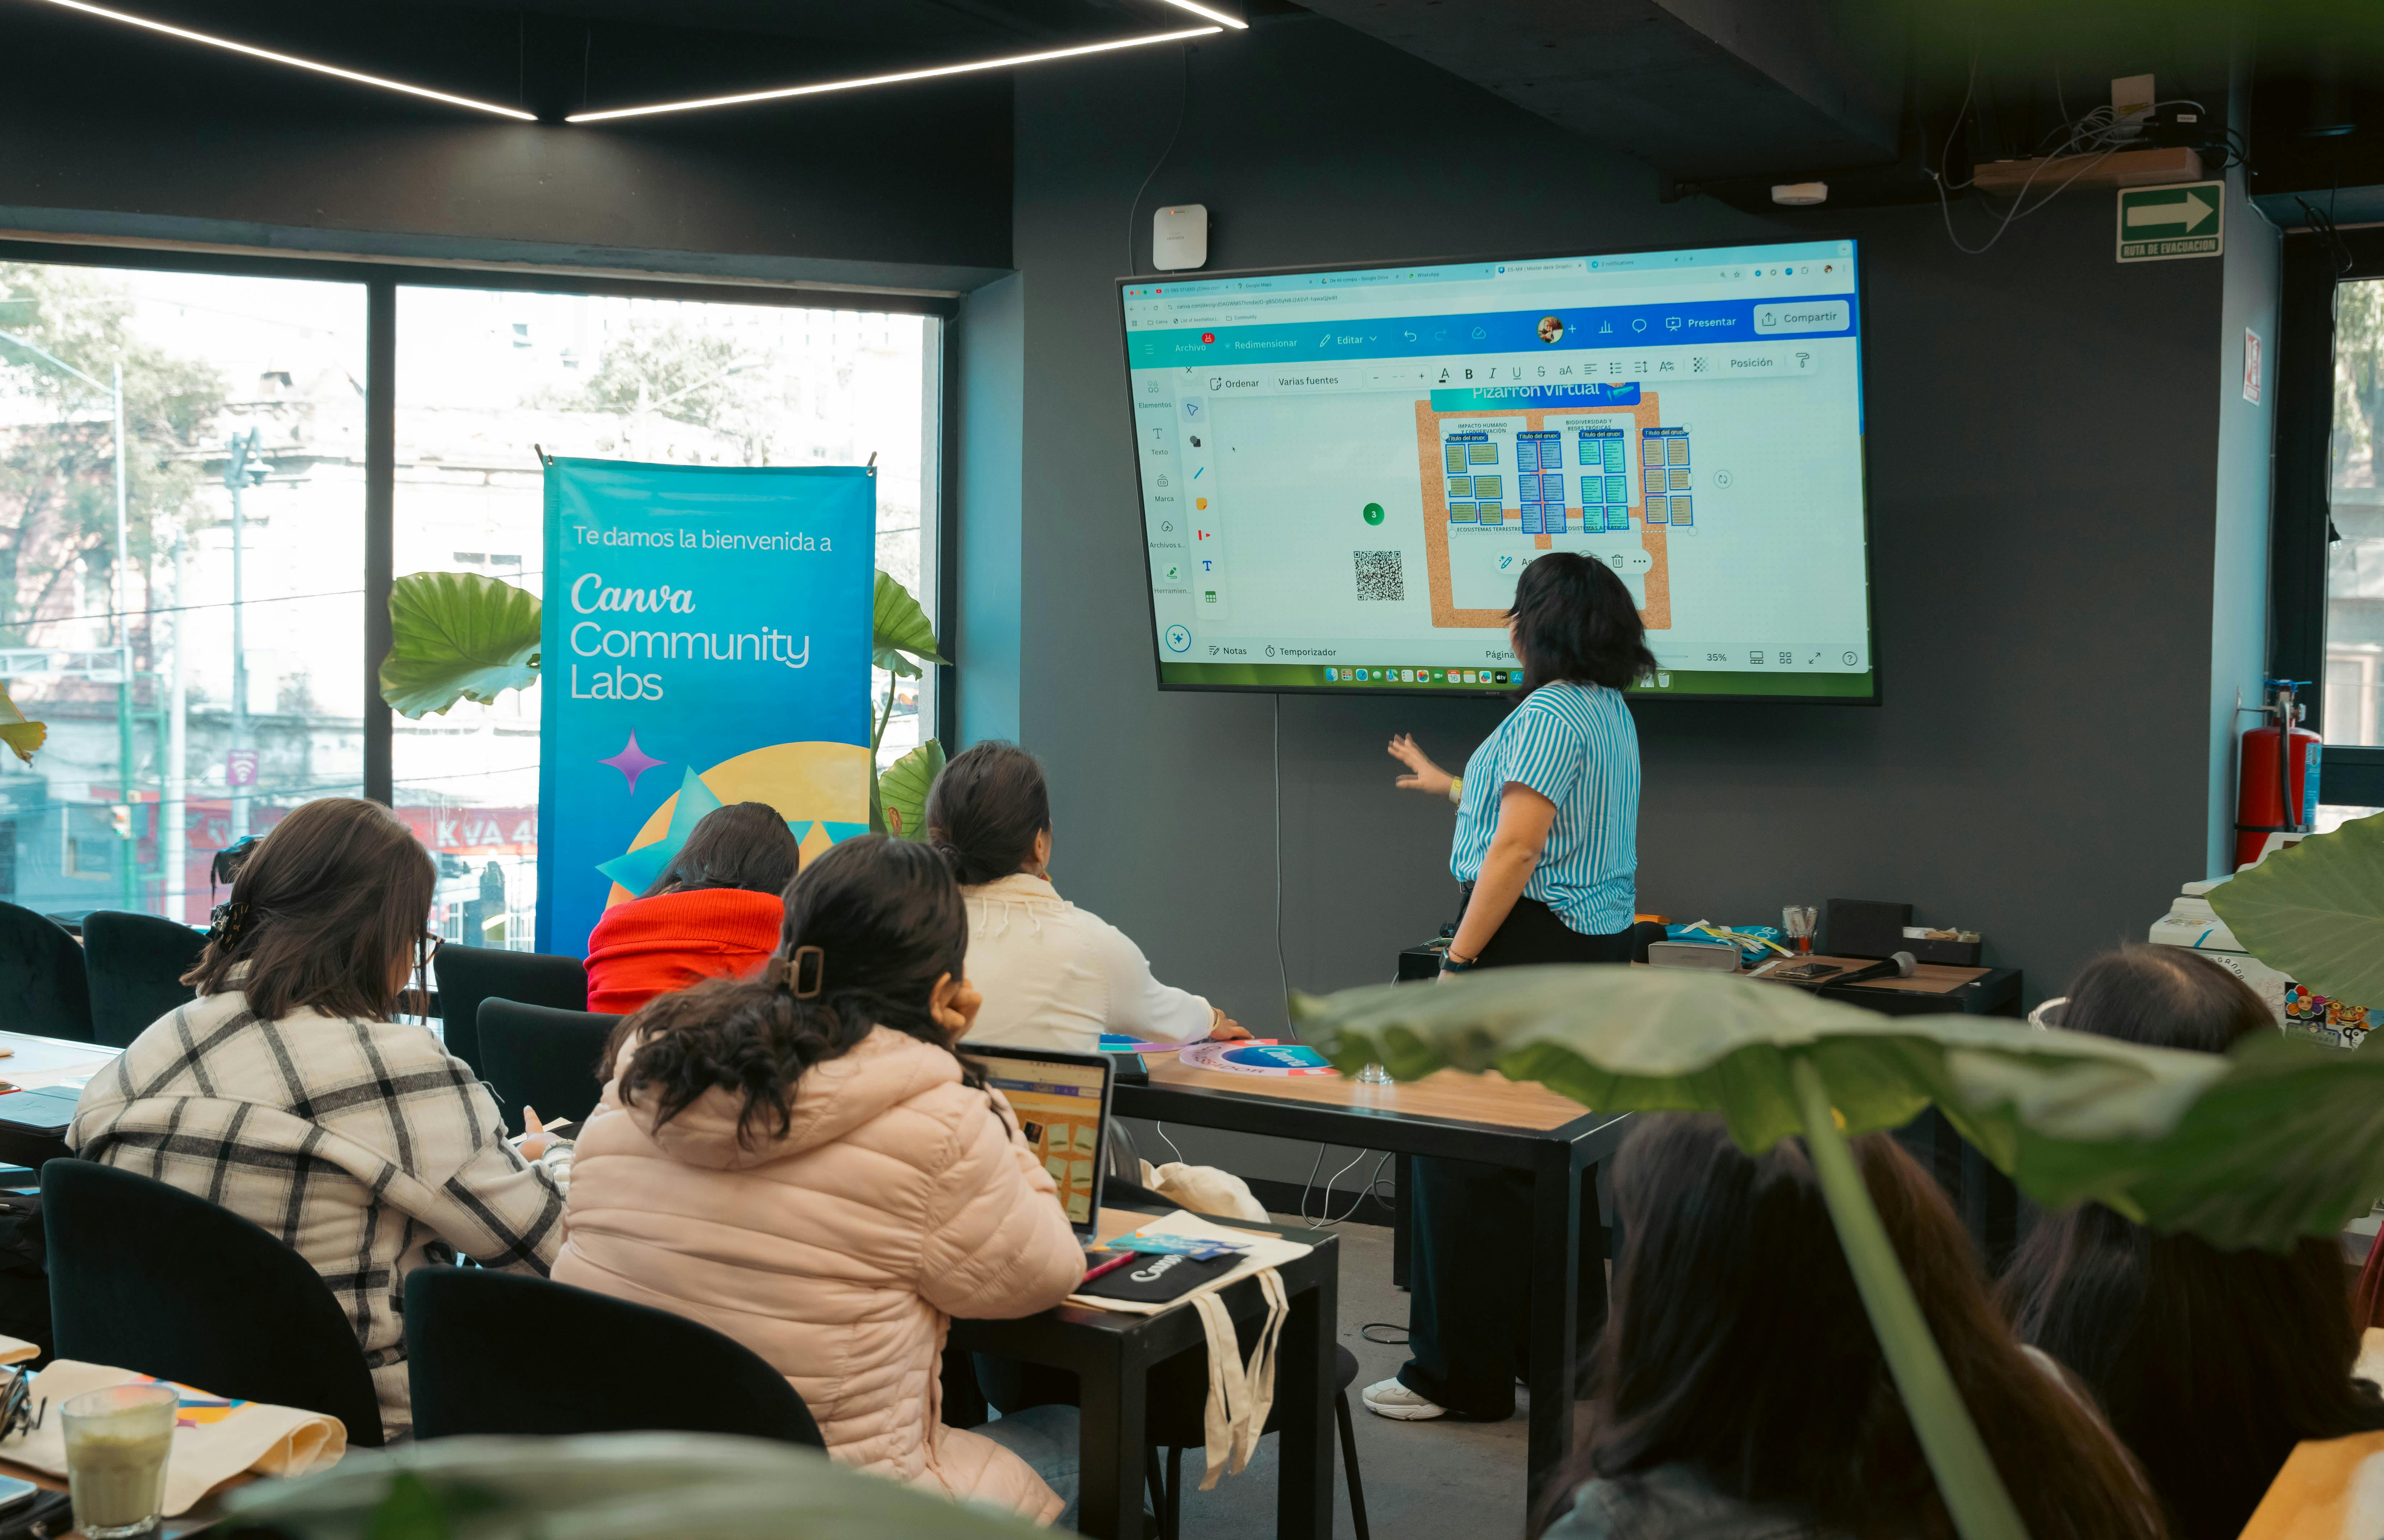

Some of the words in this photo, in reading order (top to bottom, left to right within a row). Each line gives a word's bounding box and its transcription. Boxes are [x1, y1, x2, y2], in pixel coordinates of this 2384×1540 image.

[2124, 245, 2145, 256] RUTA
[2148, 244, 2158, 255] DE
[2161, 240, 2216, 254] EVACUACION
[1688, 317, 1736, 328] Presentar
[1784, 312, 1837, 324] Compartir
[1234, 338, 1298, 350] Redimensionar
[1337, 335, 1363, 345] Editar
[1175, 343, 1206, 352] Archivo
[1730, 358, 1773, 368] Posición
[1225, 379, 1259, 388] Ordenar
[1279, 376, 1304, 386] Varias
[1306, 375, 1339, 385] fuentes
[574, 526, 599, 545] Te
[603, 526, 673, 548] damos
[679, 528, 697, 548] la
[702, 529, 816, 551] bienvenida
[820, 536, 832, 552] a
[571, 573, 696, 614] Canva
[570, 621, 810, 669] Community
[1280, 648, 1337, 657] Temporizador
[1486, 650, 1515, 659] Página
[1706, 653, 1727, 662] 35%
[571, 664, 664, 701] Labs
[512, 819, 538, 845] 4
[1258, 1047, 1310, 1067] Canva
